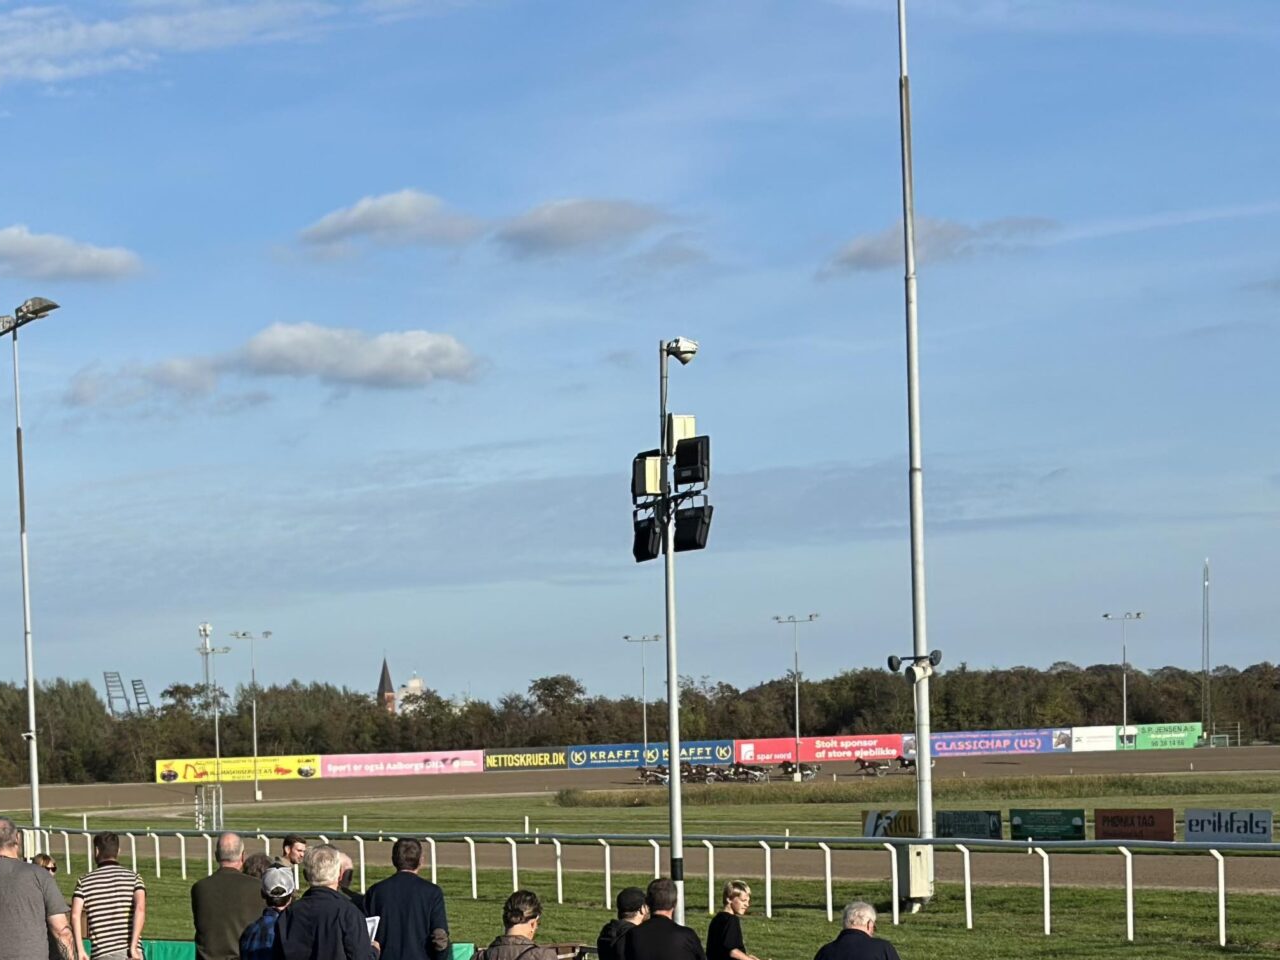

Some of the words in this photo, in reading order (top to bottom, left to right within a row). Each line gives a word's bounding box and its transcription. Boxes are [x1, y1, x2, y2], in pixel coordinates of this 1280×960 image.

[815, 739, 837, 748] Stolt
[840, 739, 878, 749] sponsor
[590, 750, 639, 759] KRAFFT
[662, 747, 711, 758] KAFFT
[815, 750, 826, 758] af
[828, 749, 852, 758] store
[486, 753, 566, 767] NETTOSKRUER.DK
[1136, 815, 1155, 827] TAG
